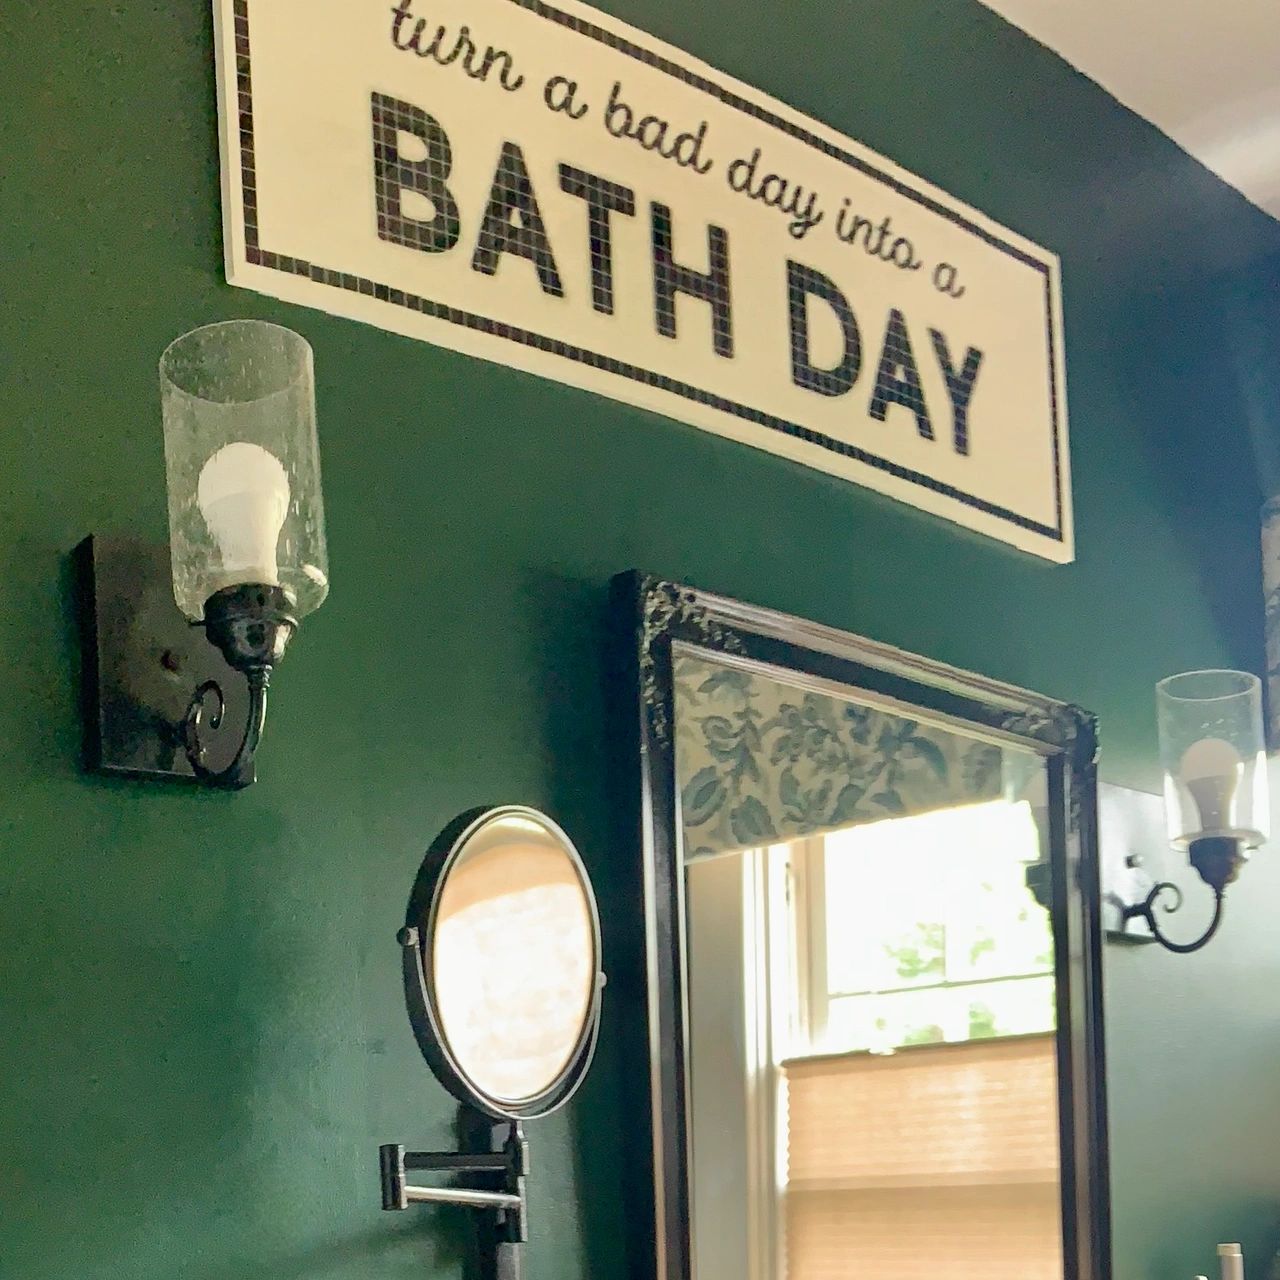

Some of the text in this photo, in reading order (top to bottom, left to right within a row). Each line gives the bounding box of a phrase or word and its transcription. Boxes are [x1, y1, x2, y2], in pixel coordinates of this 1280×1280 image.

[370, 91, 983, 457] BATH DAY
[391, 0, 965, 299] turn a bad day into a
